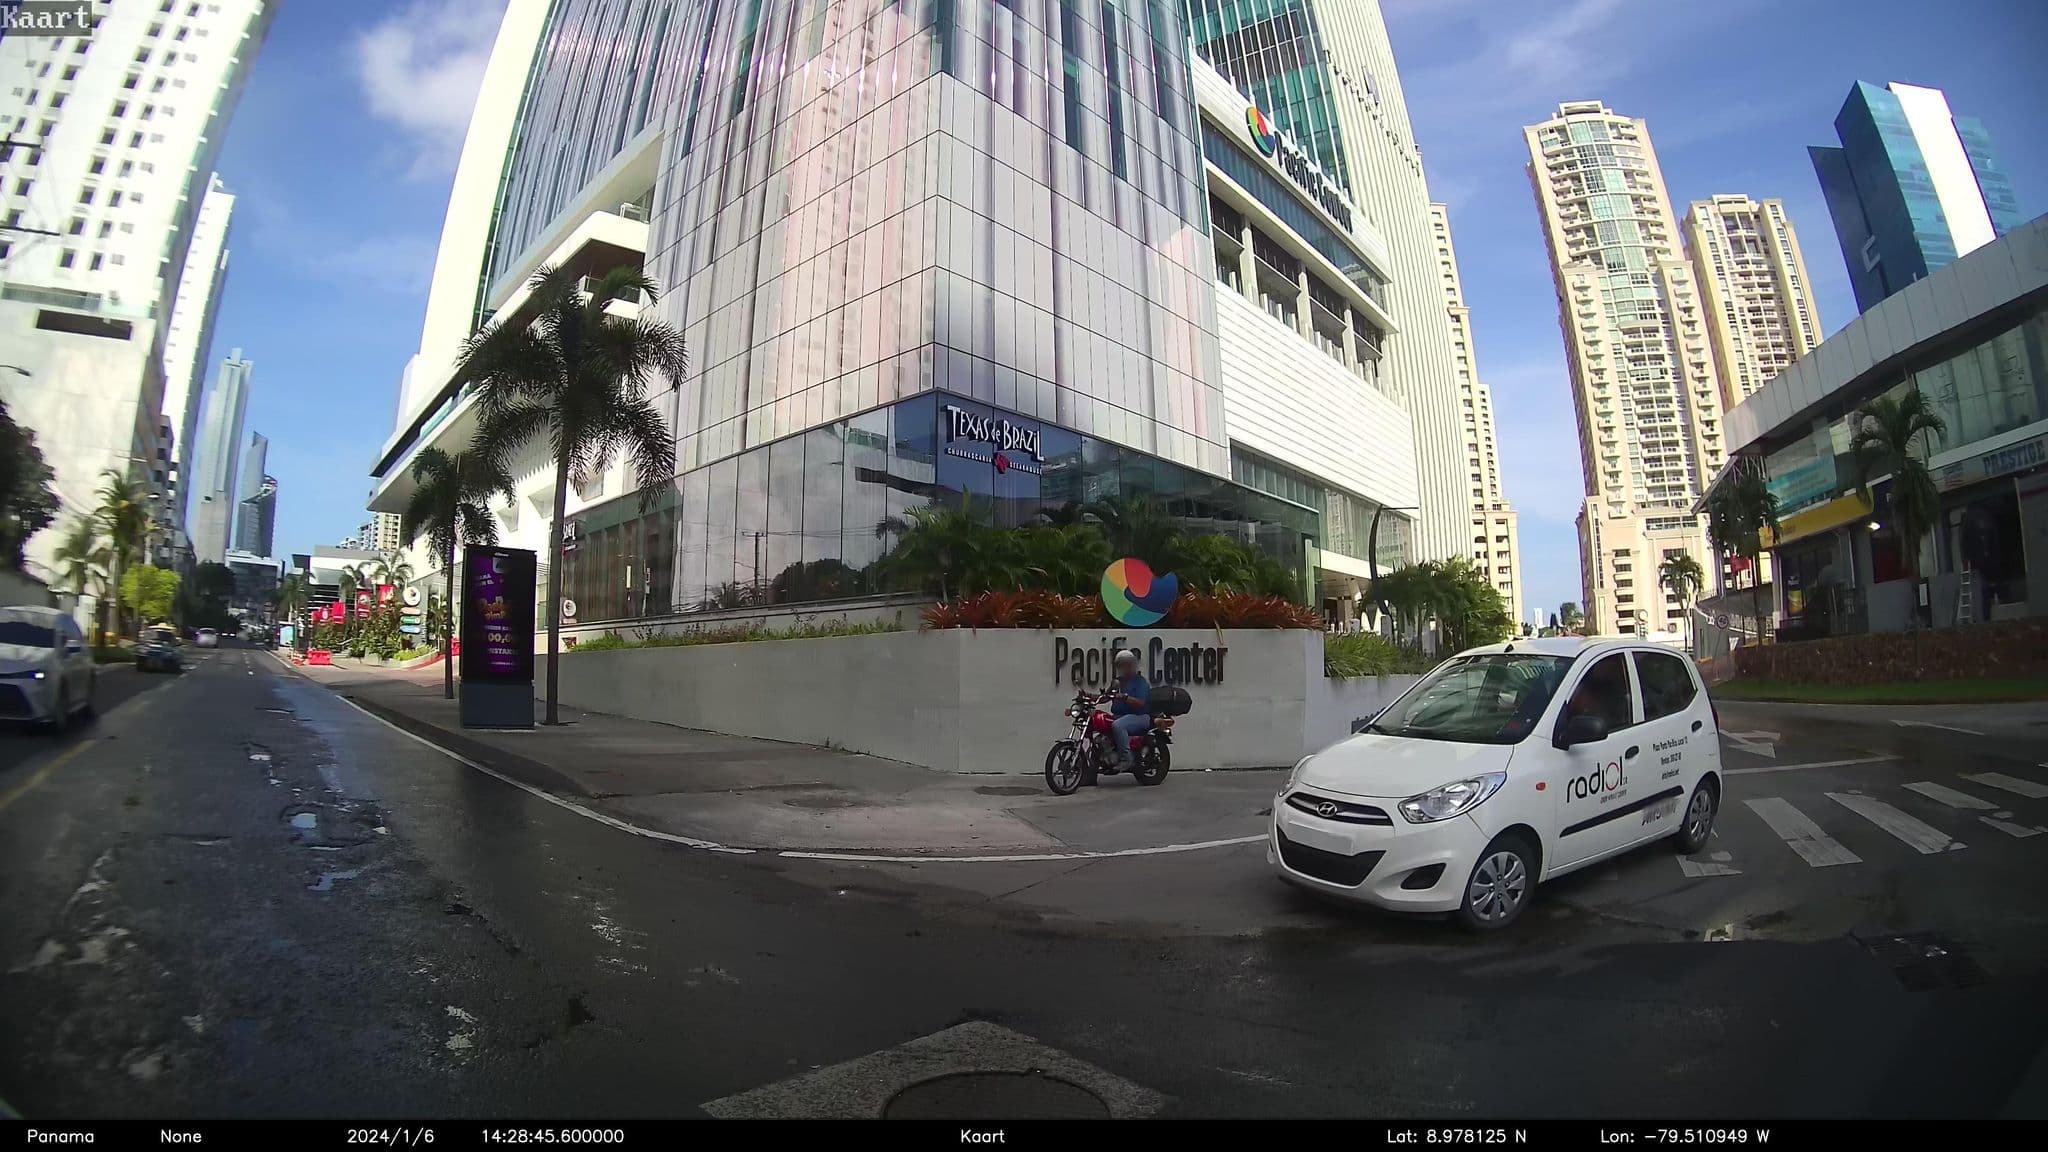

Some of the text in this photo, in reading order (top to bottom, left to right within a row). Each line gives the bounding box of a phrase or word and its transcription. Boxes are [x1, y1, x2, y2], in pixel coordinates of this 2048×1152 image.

[1274, 131, 1353, 235] Pacific Center
[947, 405, 990, 452] TEXAS
[991, 421, 1001, 443] de
[947, 447, 993, 464] CHURRASCARIA
[1983, 439, 2046, 476] PRESTIGE
[1055, 636, 1228, 686] Pacifc Center
